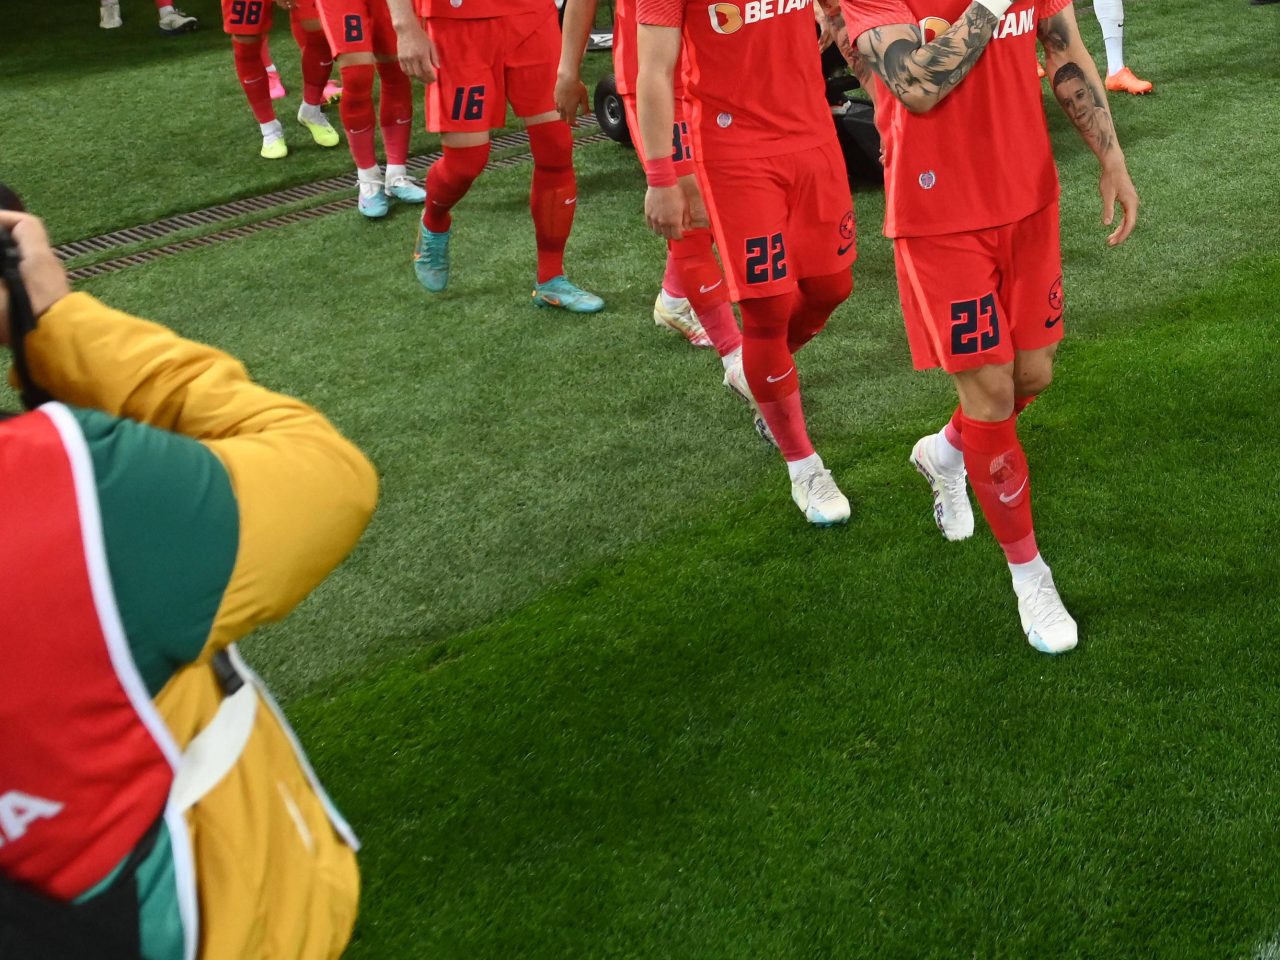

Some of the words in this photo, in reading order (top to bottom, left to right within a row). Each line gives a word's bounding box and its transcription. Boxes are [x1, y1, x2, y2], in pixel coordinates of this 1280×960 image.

[229, 0, 263, 25] 98
[344, 14, 363, 42] 8
[992, 4, 1035, 40] TAN
[451, 85, 485, 120] 16
[744, 231, 788, 286] 22
[950, 291, 1000, 357] 23
